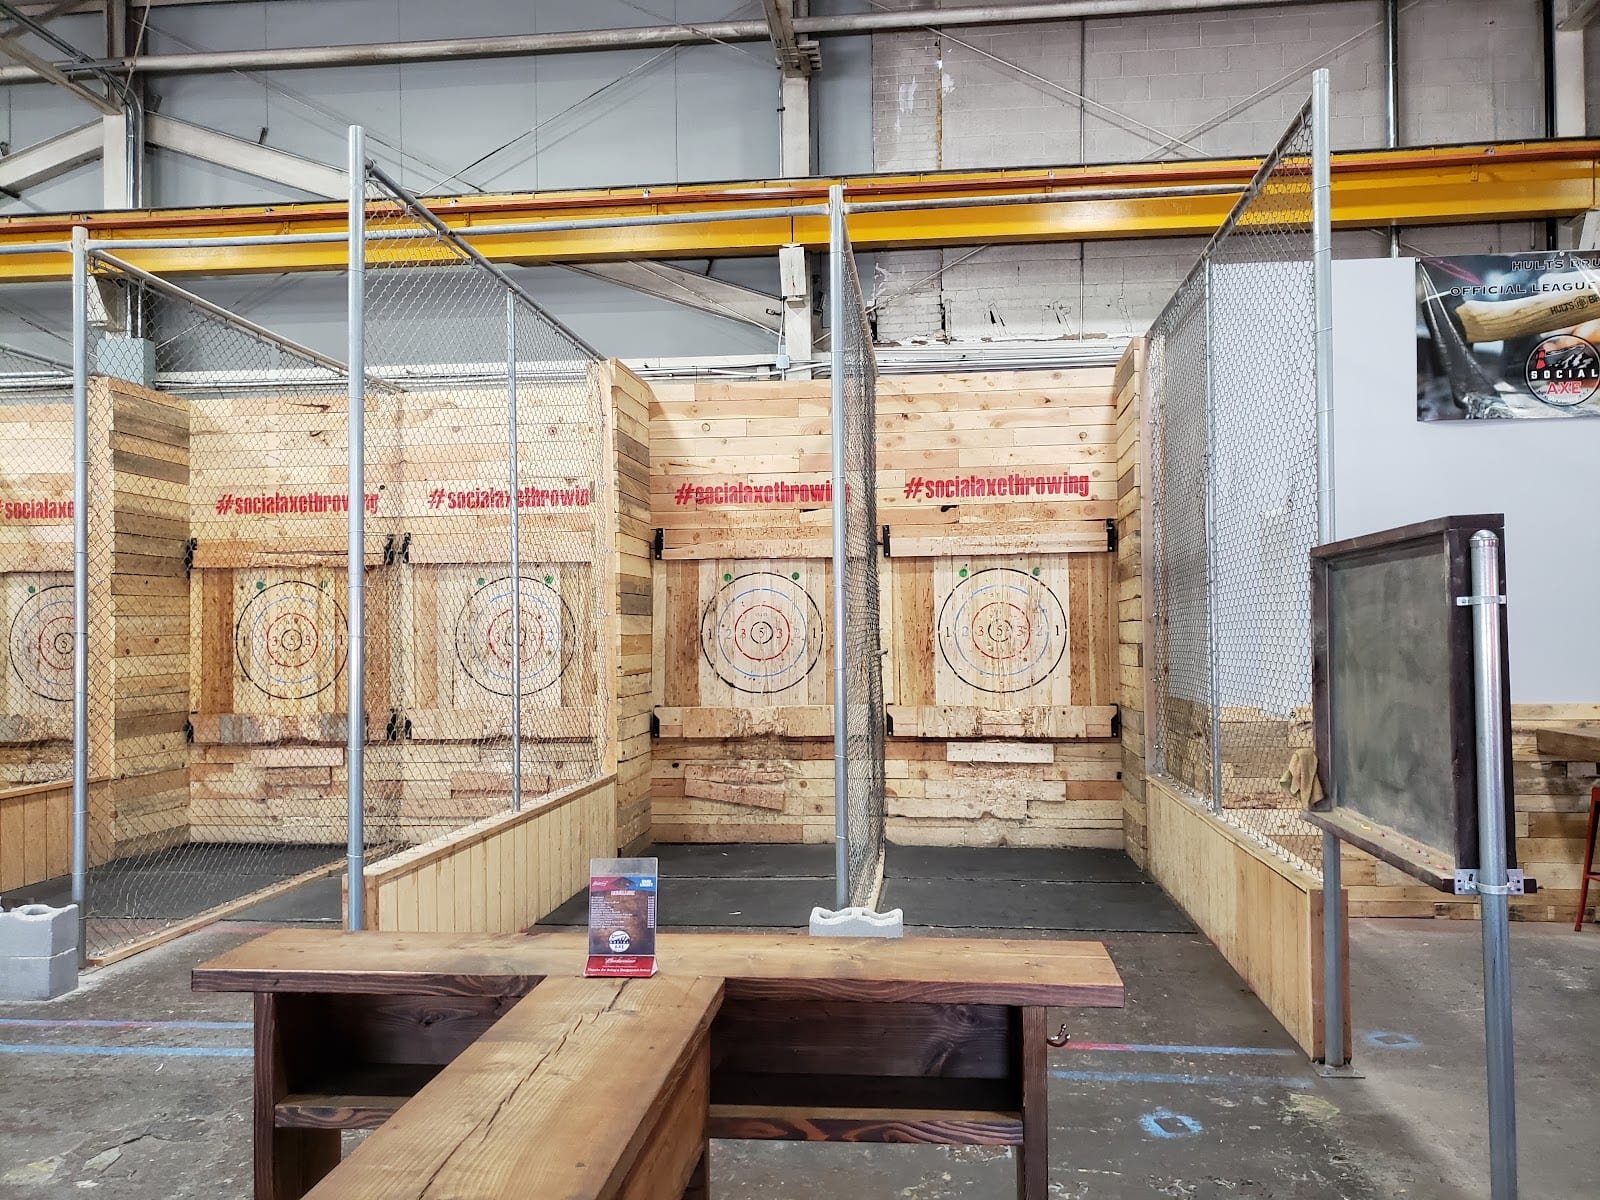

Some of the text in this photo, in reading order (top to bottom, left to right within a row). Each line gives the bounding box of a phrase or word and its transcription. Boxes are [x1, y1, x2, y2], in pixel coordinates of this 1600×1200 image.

[1511, 259, 1565, 272] HULTS
[1450, 283, 1527, 296] OFFICIAL
[1550, 301, 1575, 315] HULTS
[1530, 368, 1599, 380] SOCIAL
[1546, 381, 1582, 395] AXE
[903, 472, 1089, 499] #socialaxethrowing
[0, 498, 74, 520] socialaxe
